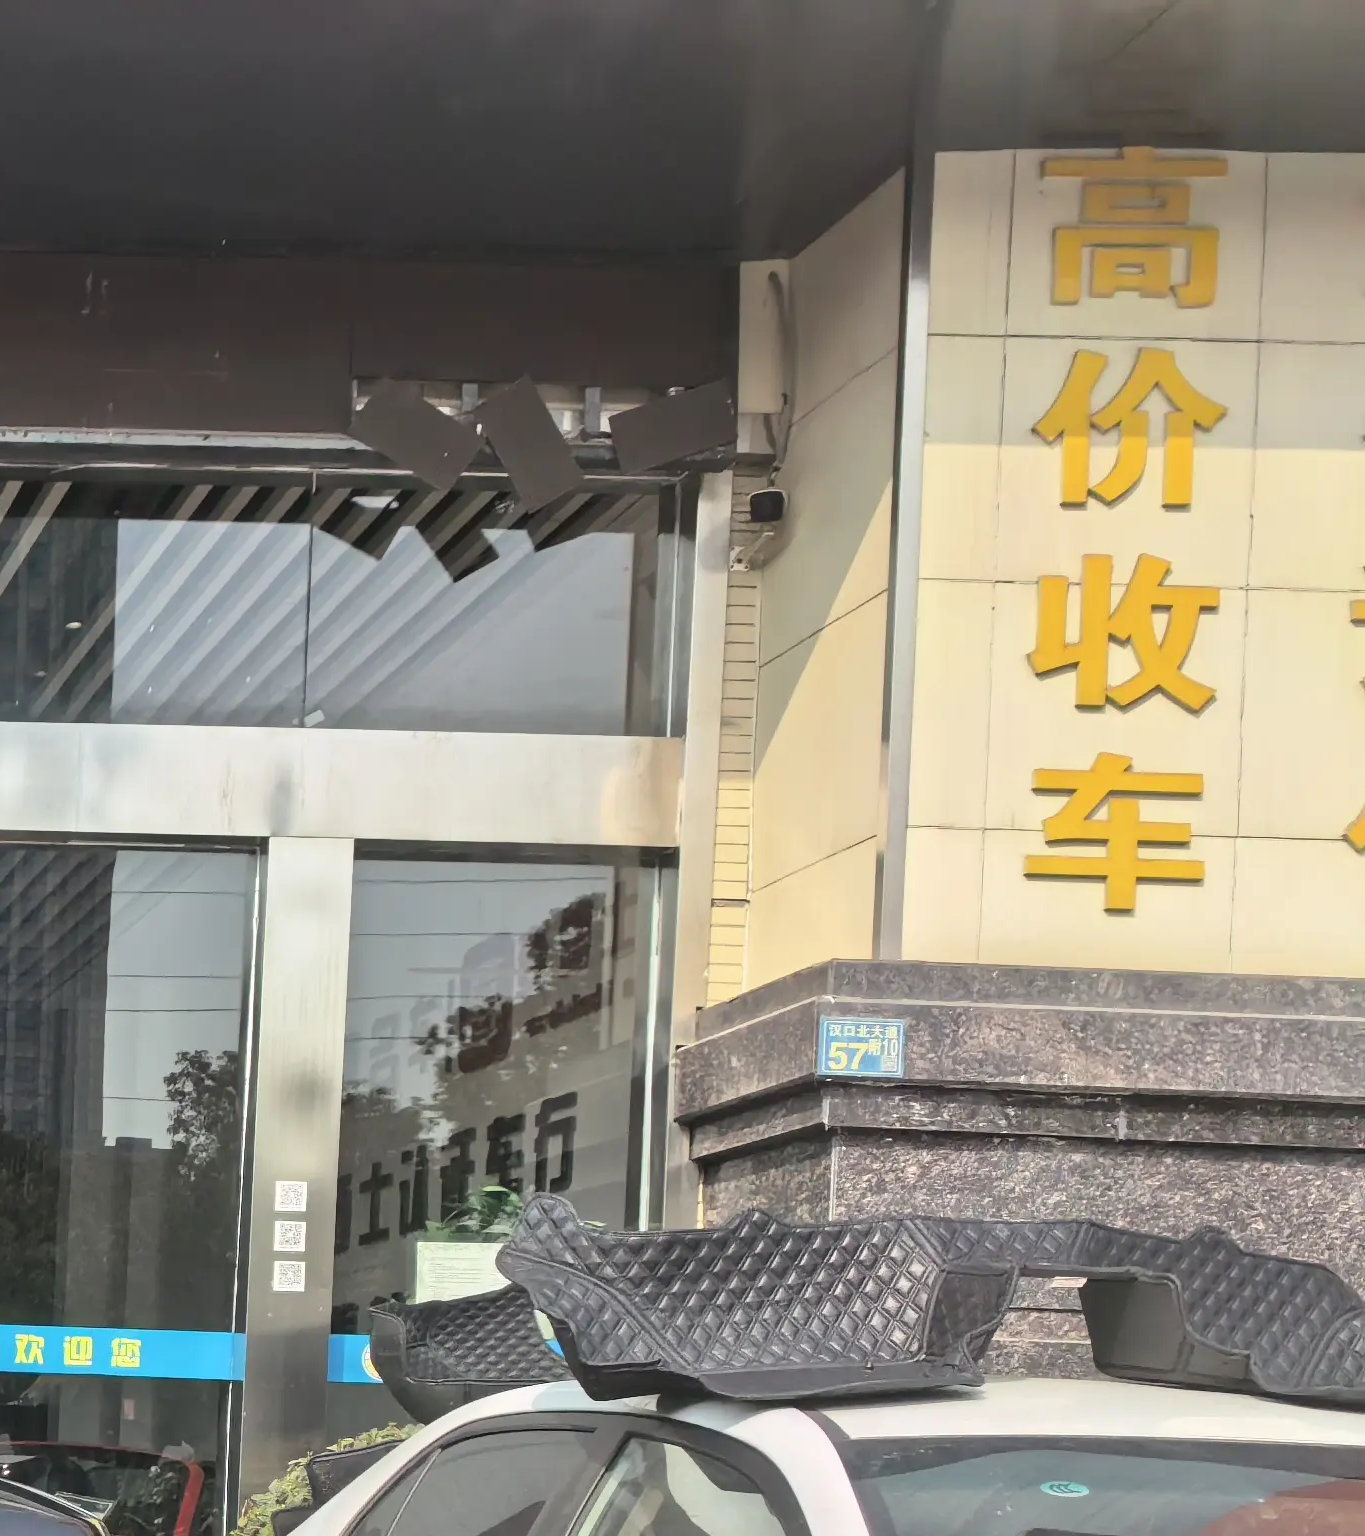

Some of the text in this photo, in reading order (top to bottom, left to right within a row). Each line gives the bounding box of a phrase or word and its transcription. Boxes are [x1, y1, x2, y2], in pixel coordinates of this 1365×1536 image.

[1023, 146, 1229, 913] 高价收车
[829, 1024, 898, 1039] 汉口北大道
[828, 1041, 869, 1071] 57
